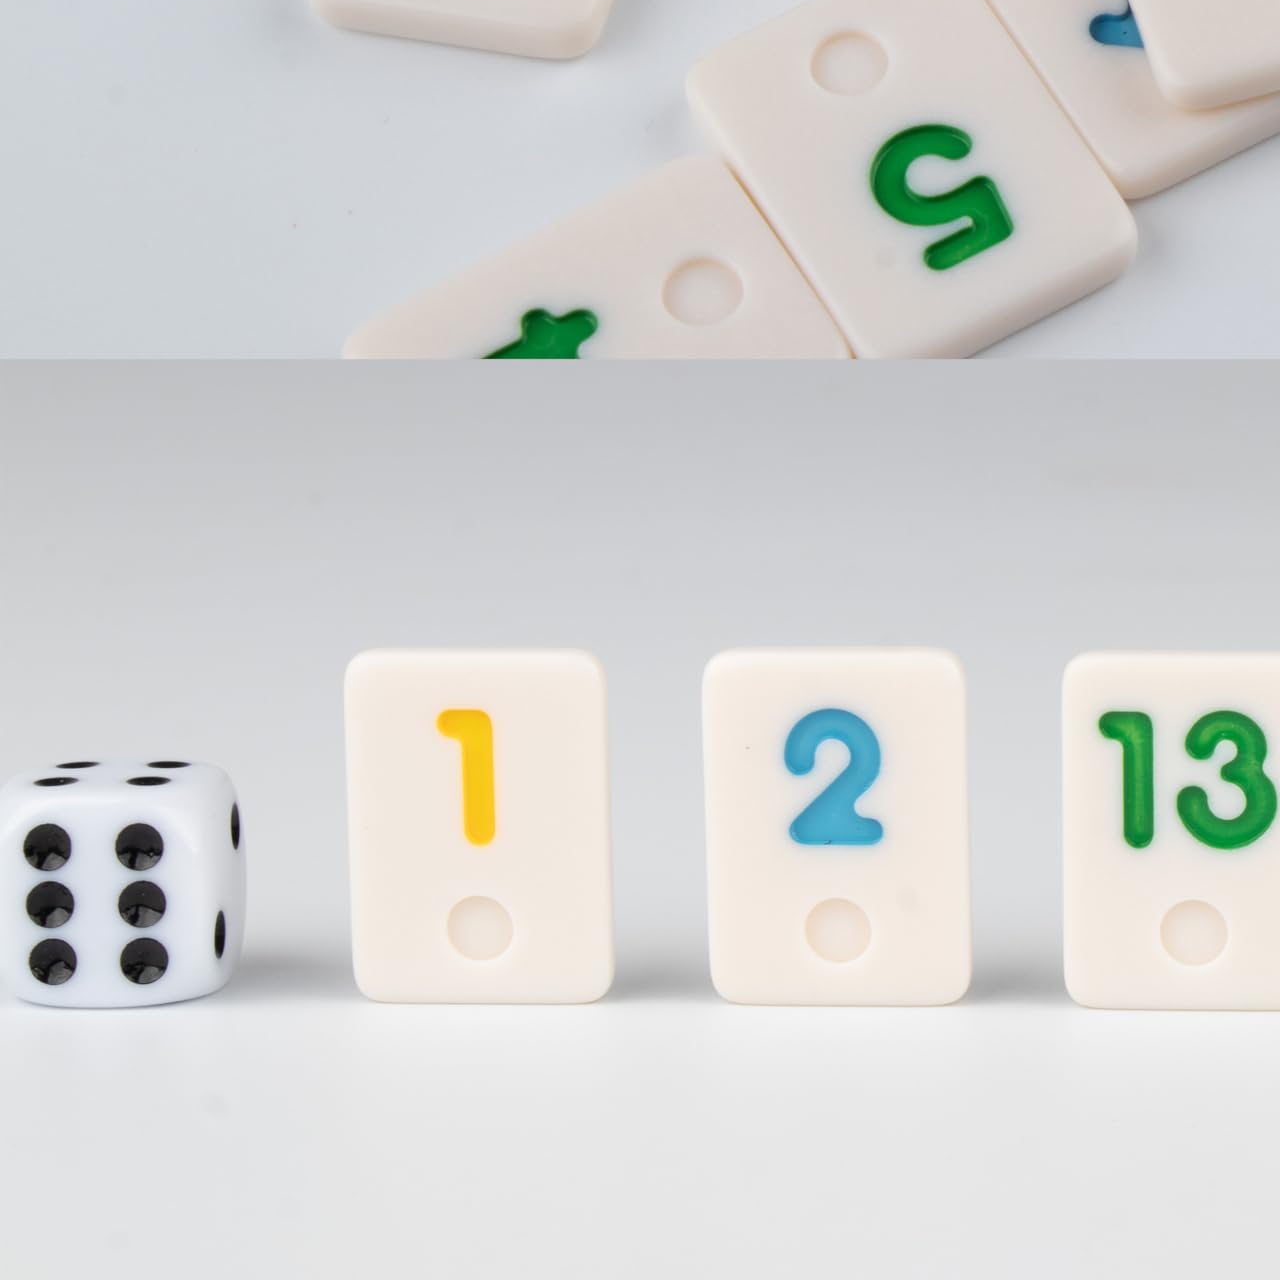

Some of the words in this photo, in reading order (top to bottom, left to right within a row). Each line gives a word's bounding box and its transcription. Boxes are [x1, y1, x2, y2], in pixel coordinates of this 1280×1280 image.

[871, 125, 1013, 270] 5
[436, 709, 496, 847] 1
[785, 709, 883, 845] 2
[1099, 712, 1277, 849] 13
